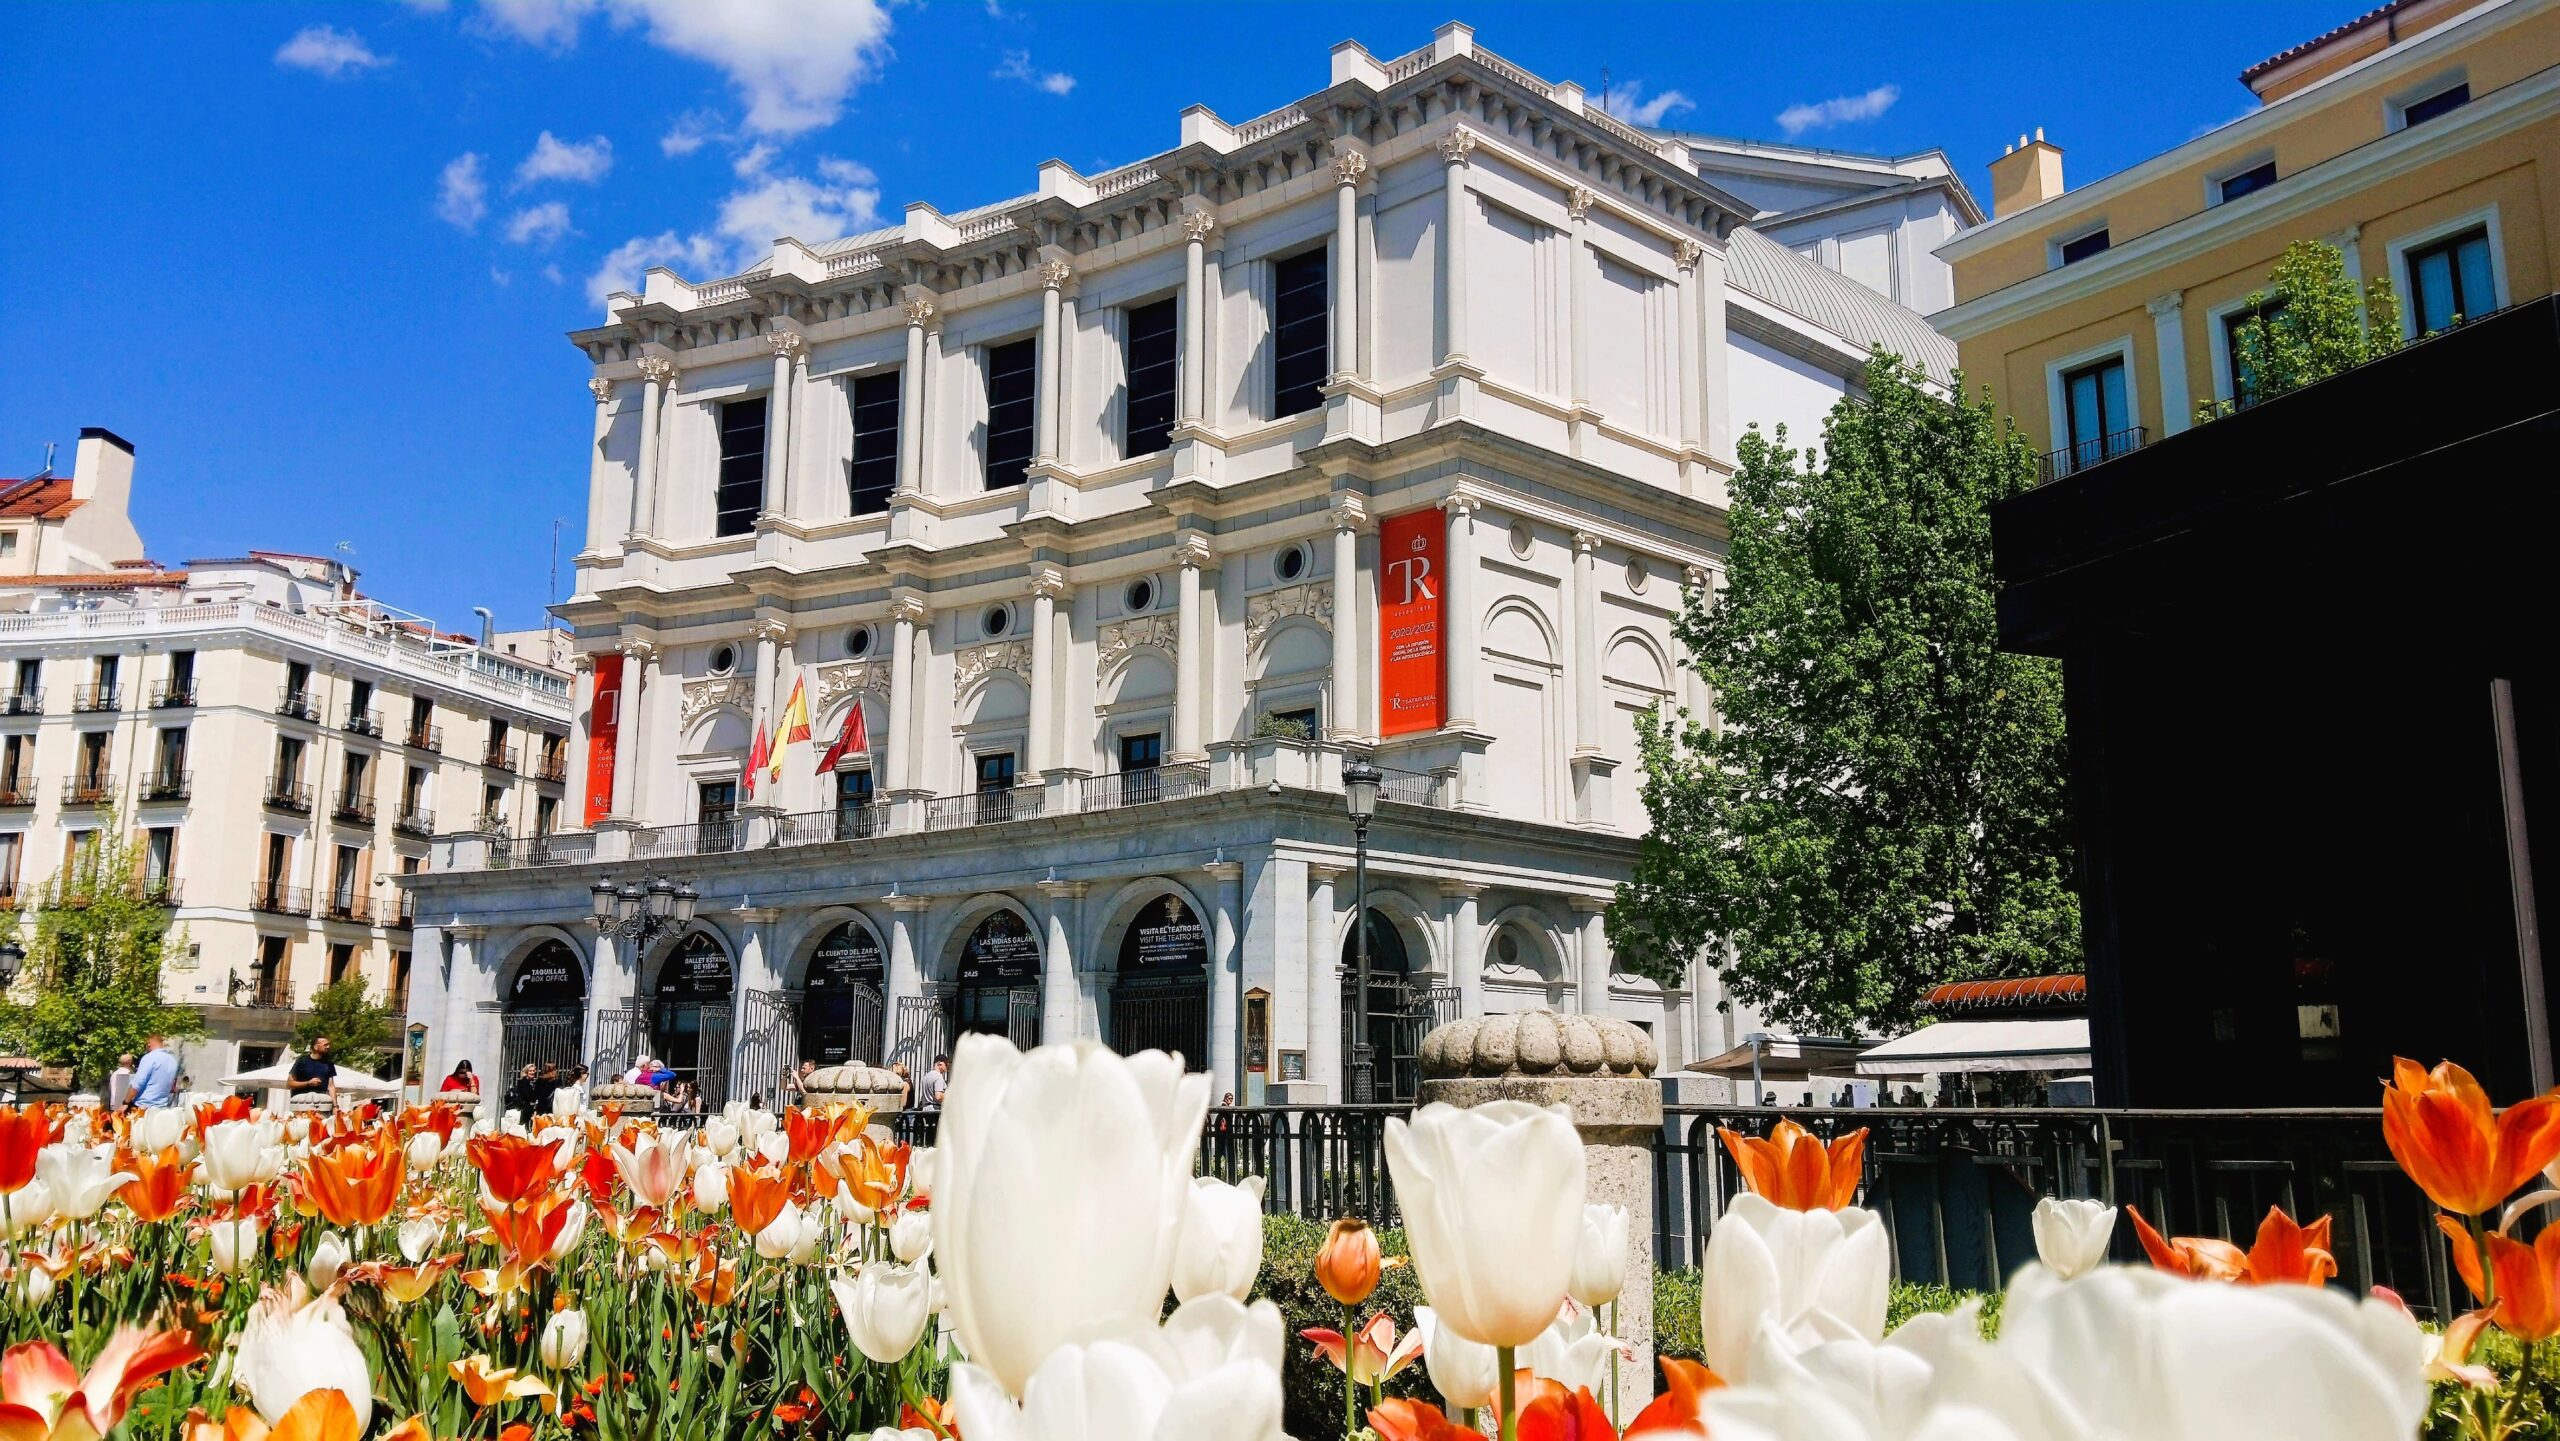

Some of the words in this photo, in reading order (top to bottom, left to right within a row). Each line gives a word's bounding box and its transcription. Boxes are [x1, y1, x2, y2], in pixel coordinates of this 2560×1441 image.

[1388, 556, 1436, 605] TR
[1389, 621, 1436, 640] 2020/2023
[1168, 925, 1192, 933] TEATRO
[991, 937, 1012, 945] INDIAS
[1168, 933, 1192, 941] TEATRO
[826, 949, 848, 957] CUENTO
[684, 957, 706, 965] BALLET
[531, 968, 567, 976] TAQUILLAS
[530, 975, 545, 983] BOX
[545, 974, 569, 982] OFFICE
